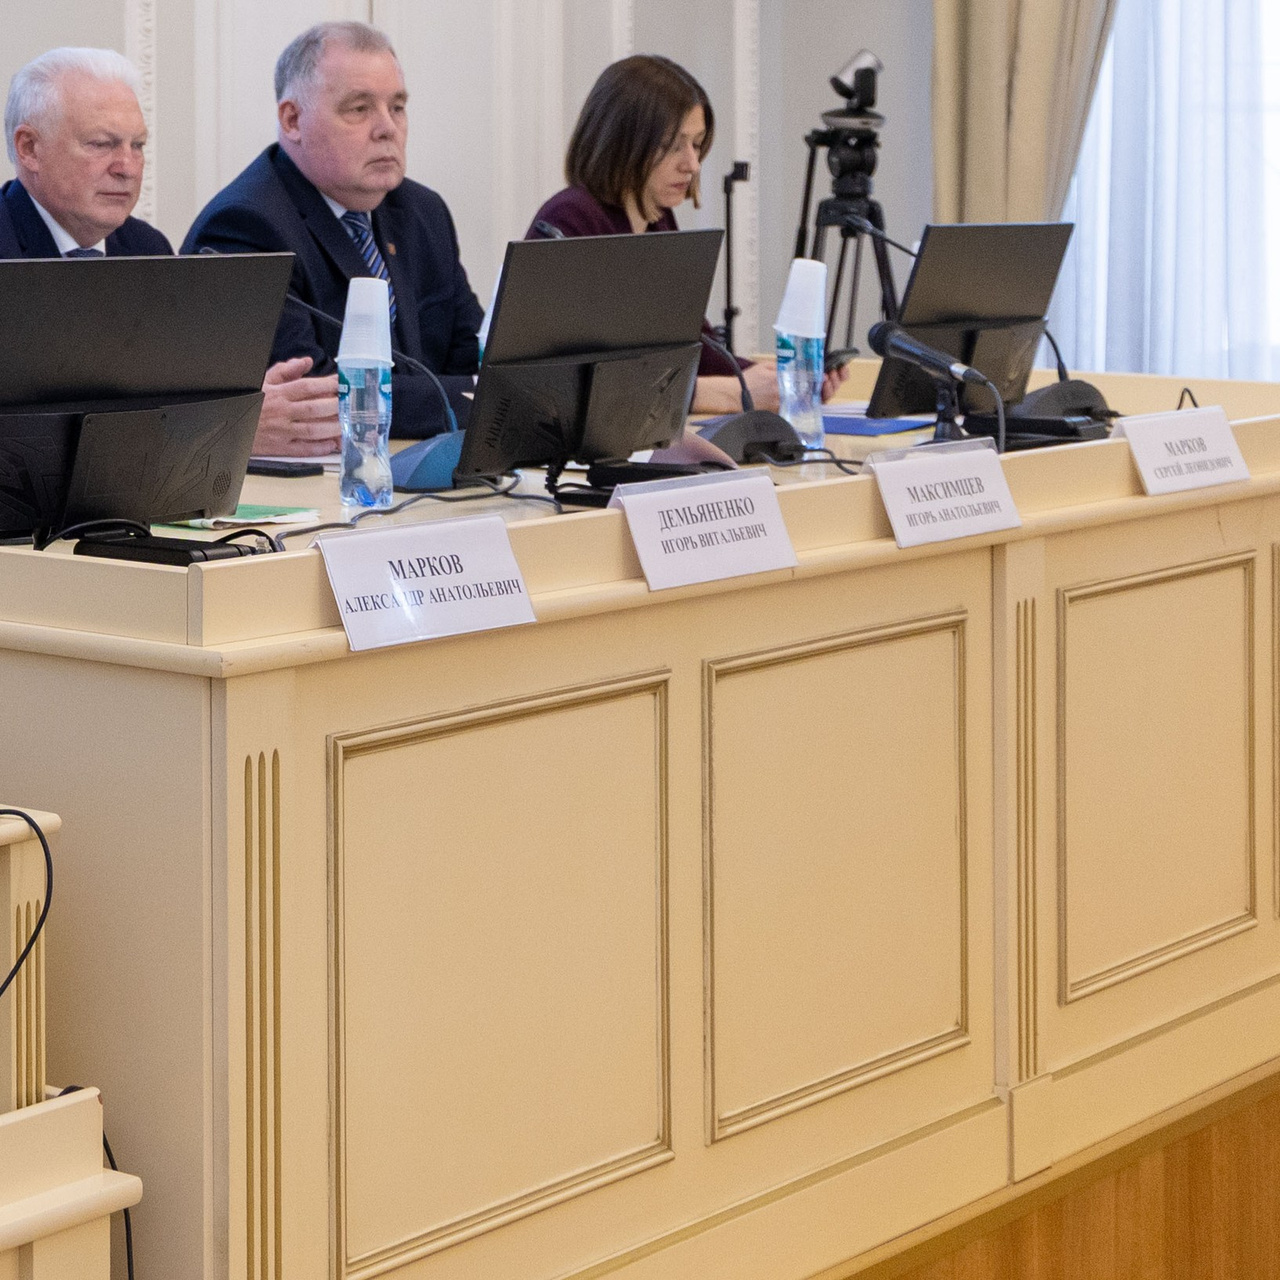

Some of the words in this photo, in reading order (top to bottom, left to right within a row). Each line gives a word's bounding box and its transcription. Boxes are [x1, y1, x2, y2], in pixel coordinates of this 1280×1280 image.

[1163, 437, 1208, 457] МАРКОВ
[906, 476, 985, 504] МАКСИМЦЕВ
[657, 496, 755, 532] ДЕМЬЯНЕНКО
[905, 511, 938, 528] ИГОРЬ
[938, 500, 1002, 522] АНАТОЛЬЕВИЧ
[660, 536, 698, 554] ИГОРЬ
[699, 523, 768, 549] ВИТАЛЬЕВИЧ
[387, 554, 464, 580] МАРКОВ
[345, 590, 425, 614] АЛЕКСАДР
[429, 578, 522, 604] АНАТОЛЬЕВИЧ
